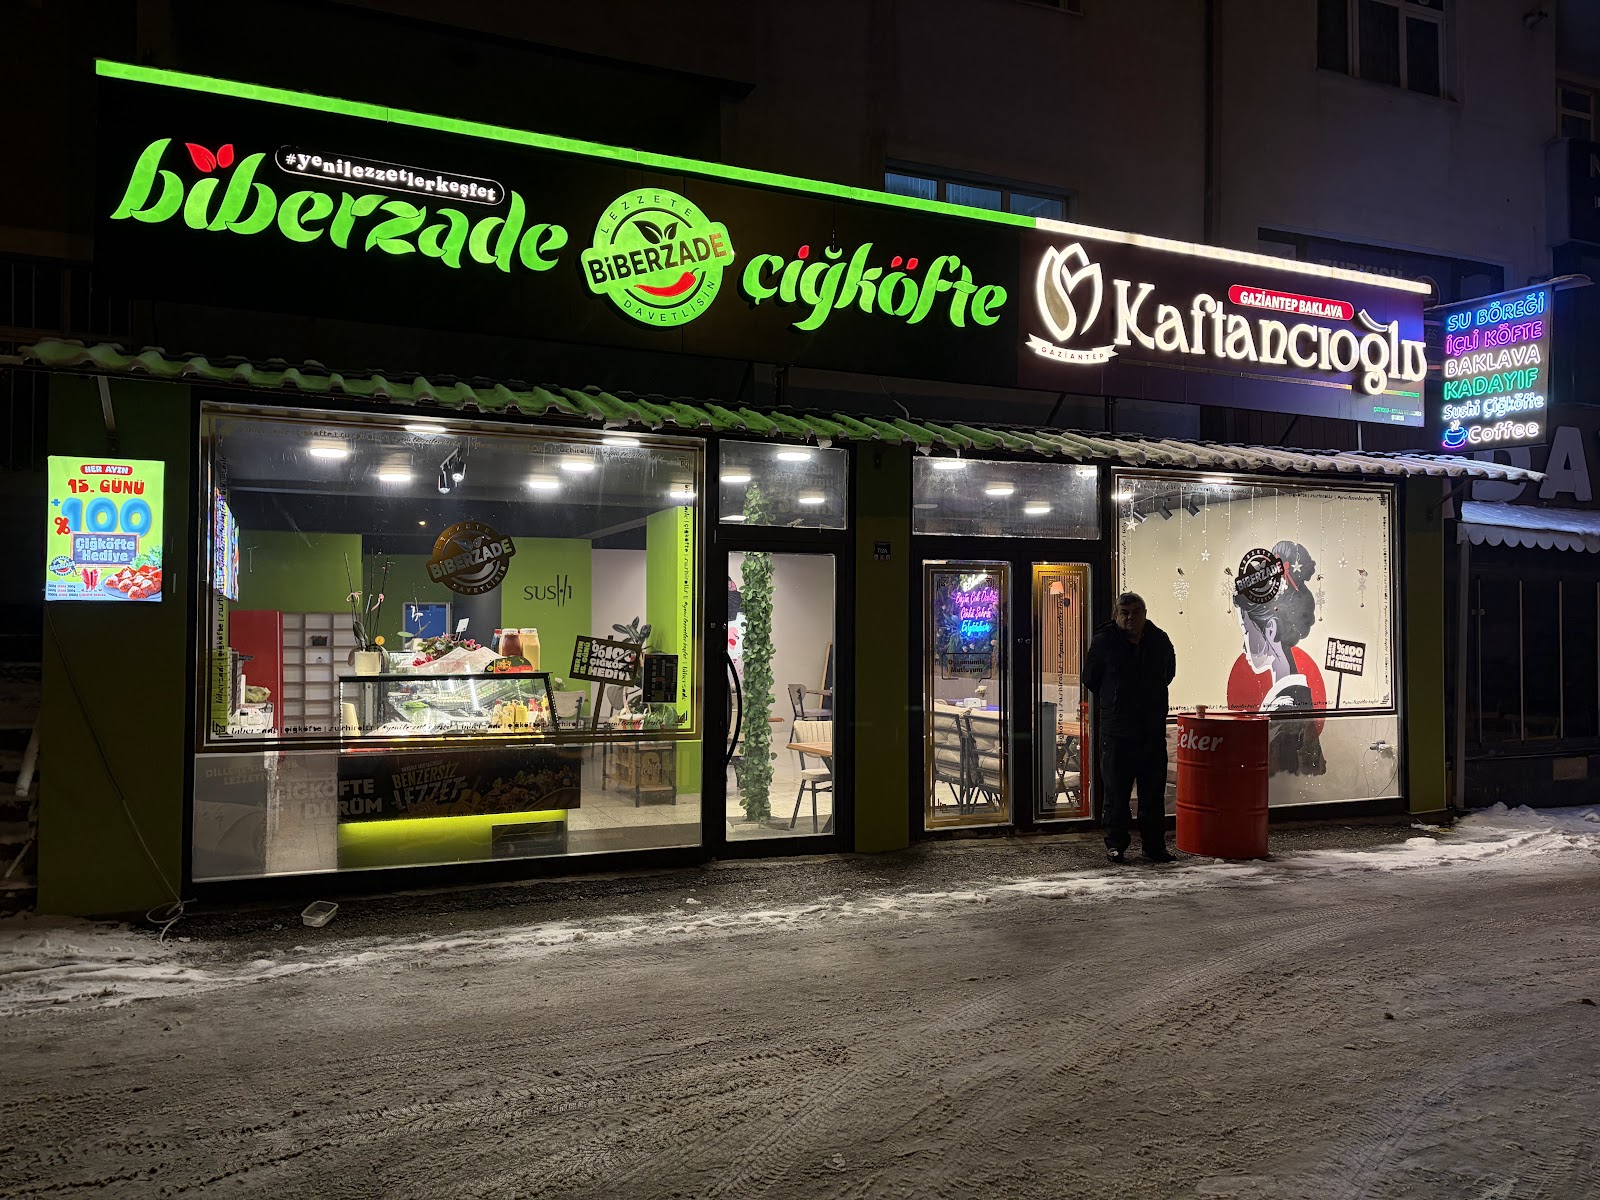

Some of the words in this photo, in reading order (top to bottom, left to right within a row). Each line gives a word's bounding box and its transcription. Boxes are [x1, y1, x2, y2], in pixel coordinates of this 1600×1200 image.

[285, 152, 496, 201] #yenilezzetlerkeşfet
[109, 137, 569, 273] biberzade
[601, 195, 692, 234] LEZZETE
[743, 243, 1008, 330] çiğköfte
[1240, 290, 1298, 312] GAZİANTEP
[1298, 300, 1343, 318] BAKLAVA
[1448, 312, 1472, 331] SU
[1477, 292, 1545, 325] BÖREĞİ
[1041, 346, 1104, 360] GAZİANTEP
[1113, 279, 1427, 395] Kaftancıoğlu
[1446, 329, 1480, 356] İÇLİ
[1484, 321, 1543, 347] KÖFTE
[1445, 344, 1541, 378] BAKLAVA
[1444, 368, 1539, 400] KADAYIF
[1443, 399, 1481, 420] Sushi
[1467, 420, 1540, 443] Coffee
[68, 479, 95, 494] 15.
[99, 478, 145, 495] GÜNÜ
[84, 466, 102, 474] HER
[105, 466, 129, 475] AYIN
[82, 549, 128, 562] Hediye
[1177, 728, 1224, 752] eker
